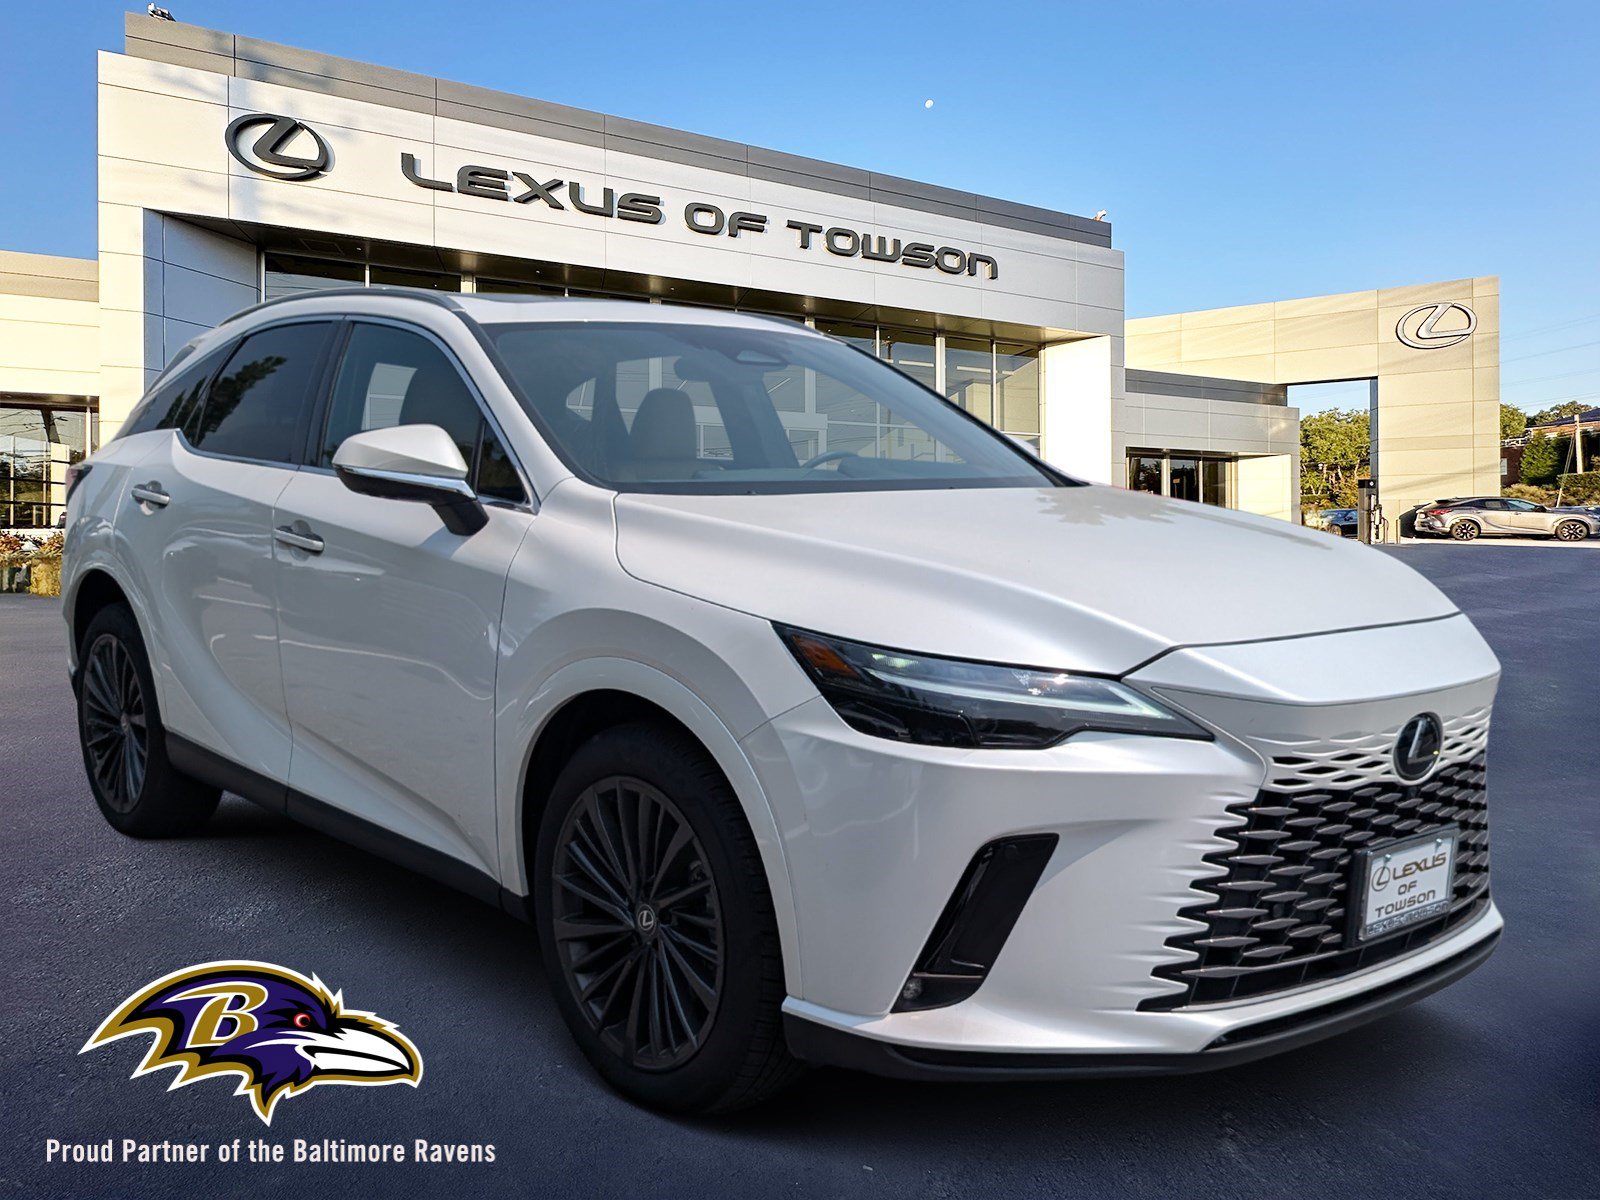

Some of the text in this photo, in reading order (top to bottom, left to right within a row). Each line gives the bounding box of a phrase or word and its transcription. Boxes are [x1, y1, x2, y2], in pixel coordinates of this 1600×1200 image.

[401, 152, 999, 280] LEXUS OF TOWSON
[1392, 852, 1447, 880] LEXUS
[1398, 880, 1418, 896] OF
[1375, 889, 1436, 918] TOWSON
